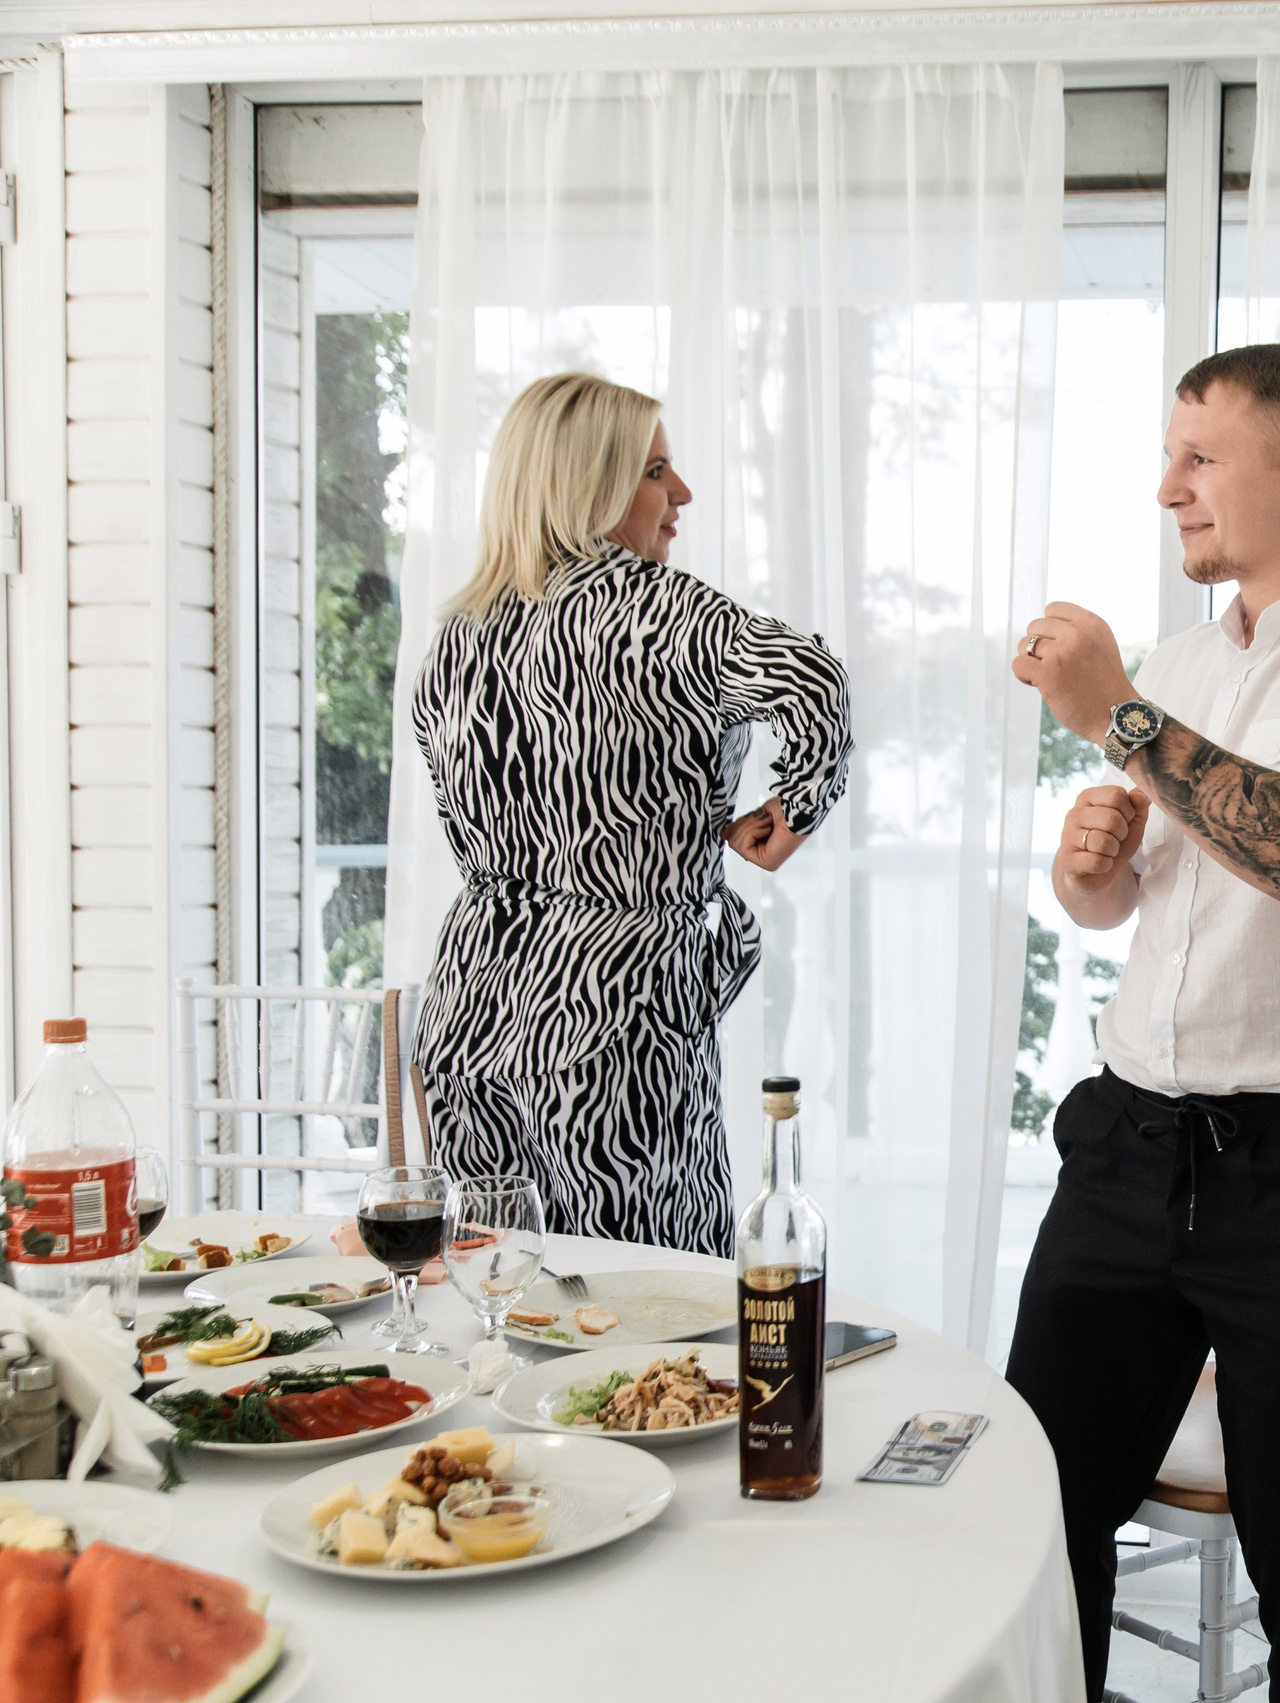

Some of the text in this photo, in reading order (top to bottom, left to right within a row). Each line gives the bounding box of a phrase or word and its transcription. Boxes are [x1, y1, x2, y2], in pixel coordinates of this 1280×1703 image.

[750, 1269, 787, 1278] КОНЬЯК
[744, 1296, 794, 1321] ЗОЛОТОЙ
[749, 1322, 787, 1345] АИСТ
[749, 1344, 788, 1353] КОНЬЯК
